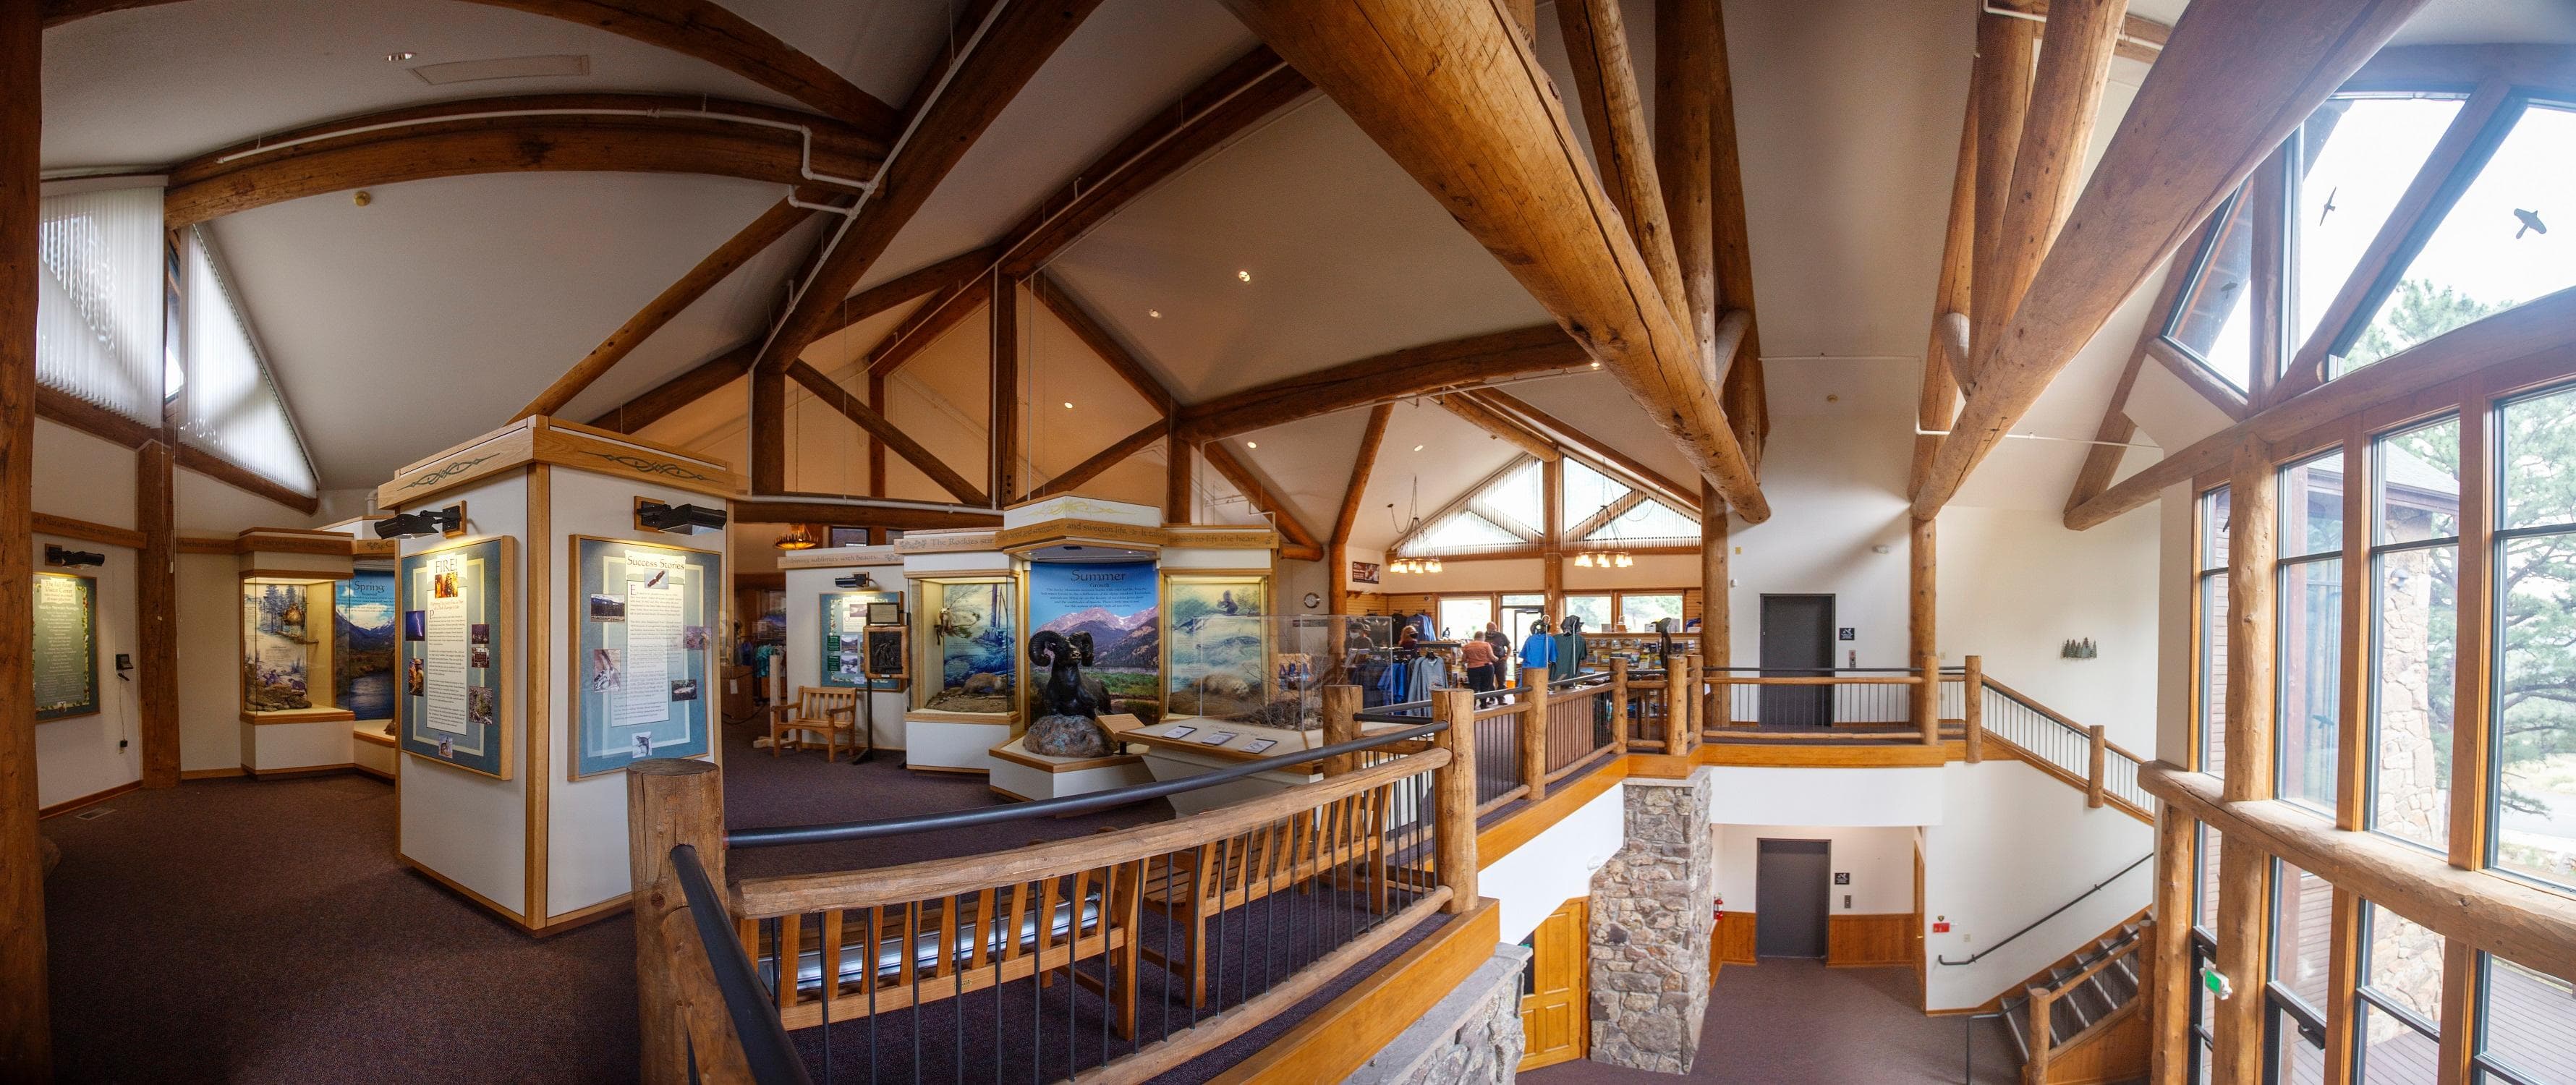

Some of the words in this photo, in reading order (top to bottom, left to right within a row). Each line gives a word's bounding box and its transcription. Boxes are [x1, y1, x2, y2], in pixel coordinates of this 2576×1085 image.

[1082, 524, 1113, 532] sweeten
[435, 558, 457, 574] FIRE!
[626, 556, 658, 568] Success
[659, 558, 684, 570] Stories
[1071, 569, 1126, 582] Summer
[354, 580, 385, 593] Spring
